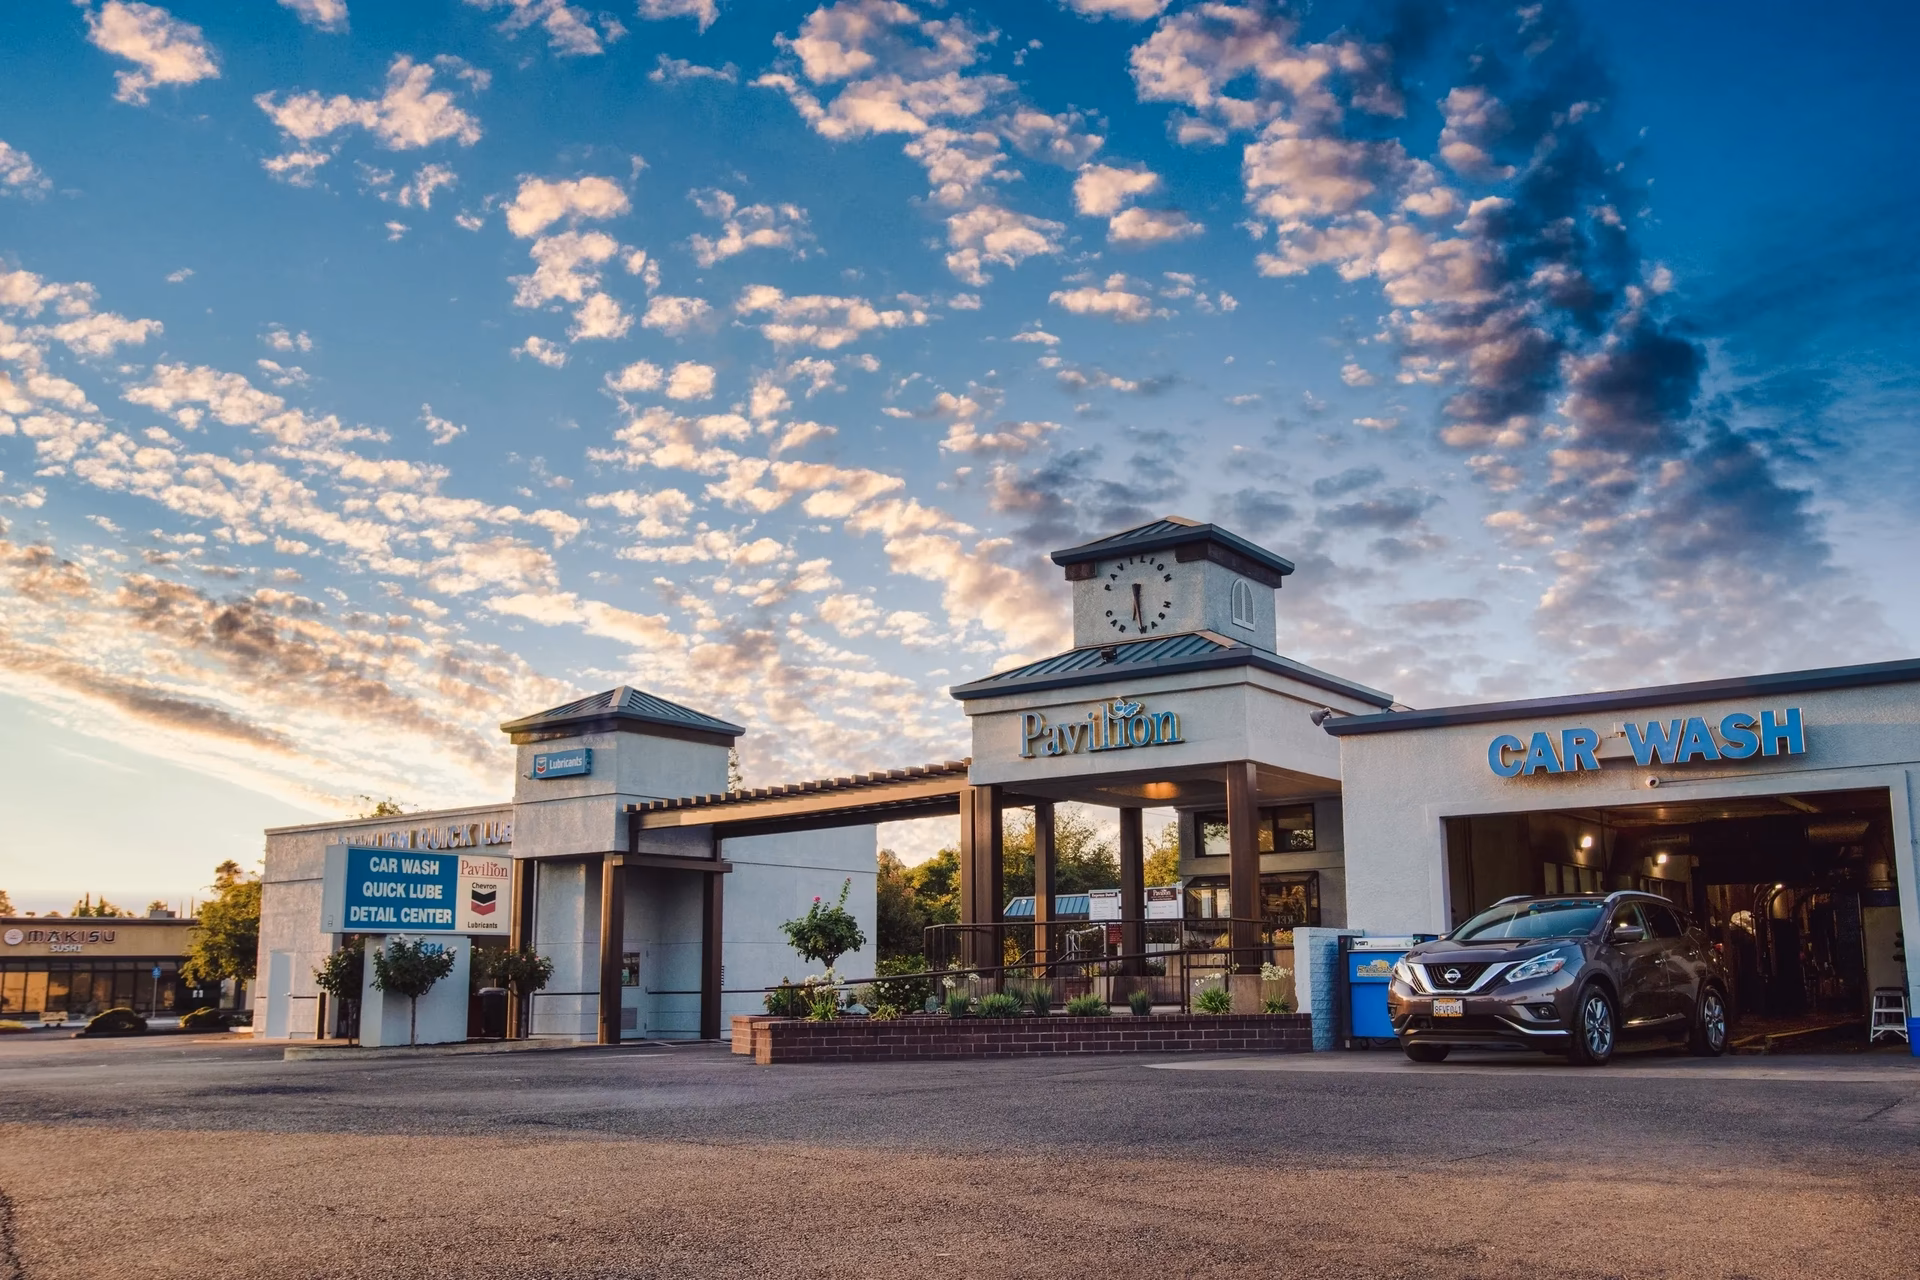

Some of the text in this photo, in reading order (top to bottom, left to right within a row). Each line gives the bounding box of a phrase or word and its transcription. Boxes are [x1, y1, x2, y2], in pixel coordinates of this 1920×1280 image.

[1104, 555, 1172, 592] PAVILION
[1105, 600, 1172, 634] CAR WASH
[1018, 701, 1185, 758] Pavilion
[1487, 707, 1806, 778] CAR WASH
[549, 756, 582, 769] Lubricants
[417, 823, 479, 850] QUICK
[370, 857, 439, 875] CAR WASH
[461, 860, 508, 877] Pavilion
[363, 881, 443, 899] QUICK LUBE
[472, 882, 497, 890] Chevron
[350, 906, 452, 923] DETAIL CENTER
[27, 930, 116, 944] MAKISU
[51, 944, 83, 952] SUSHI
